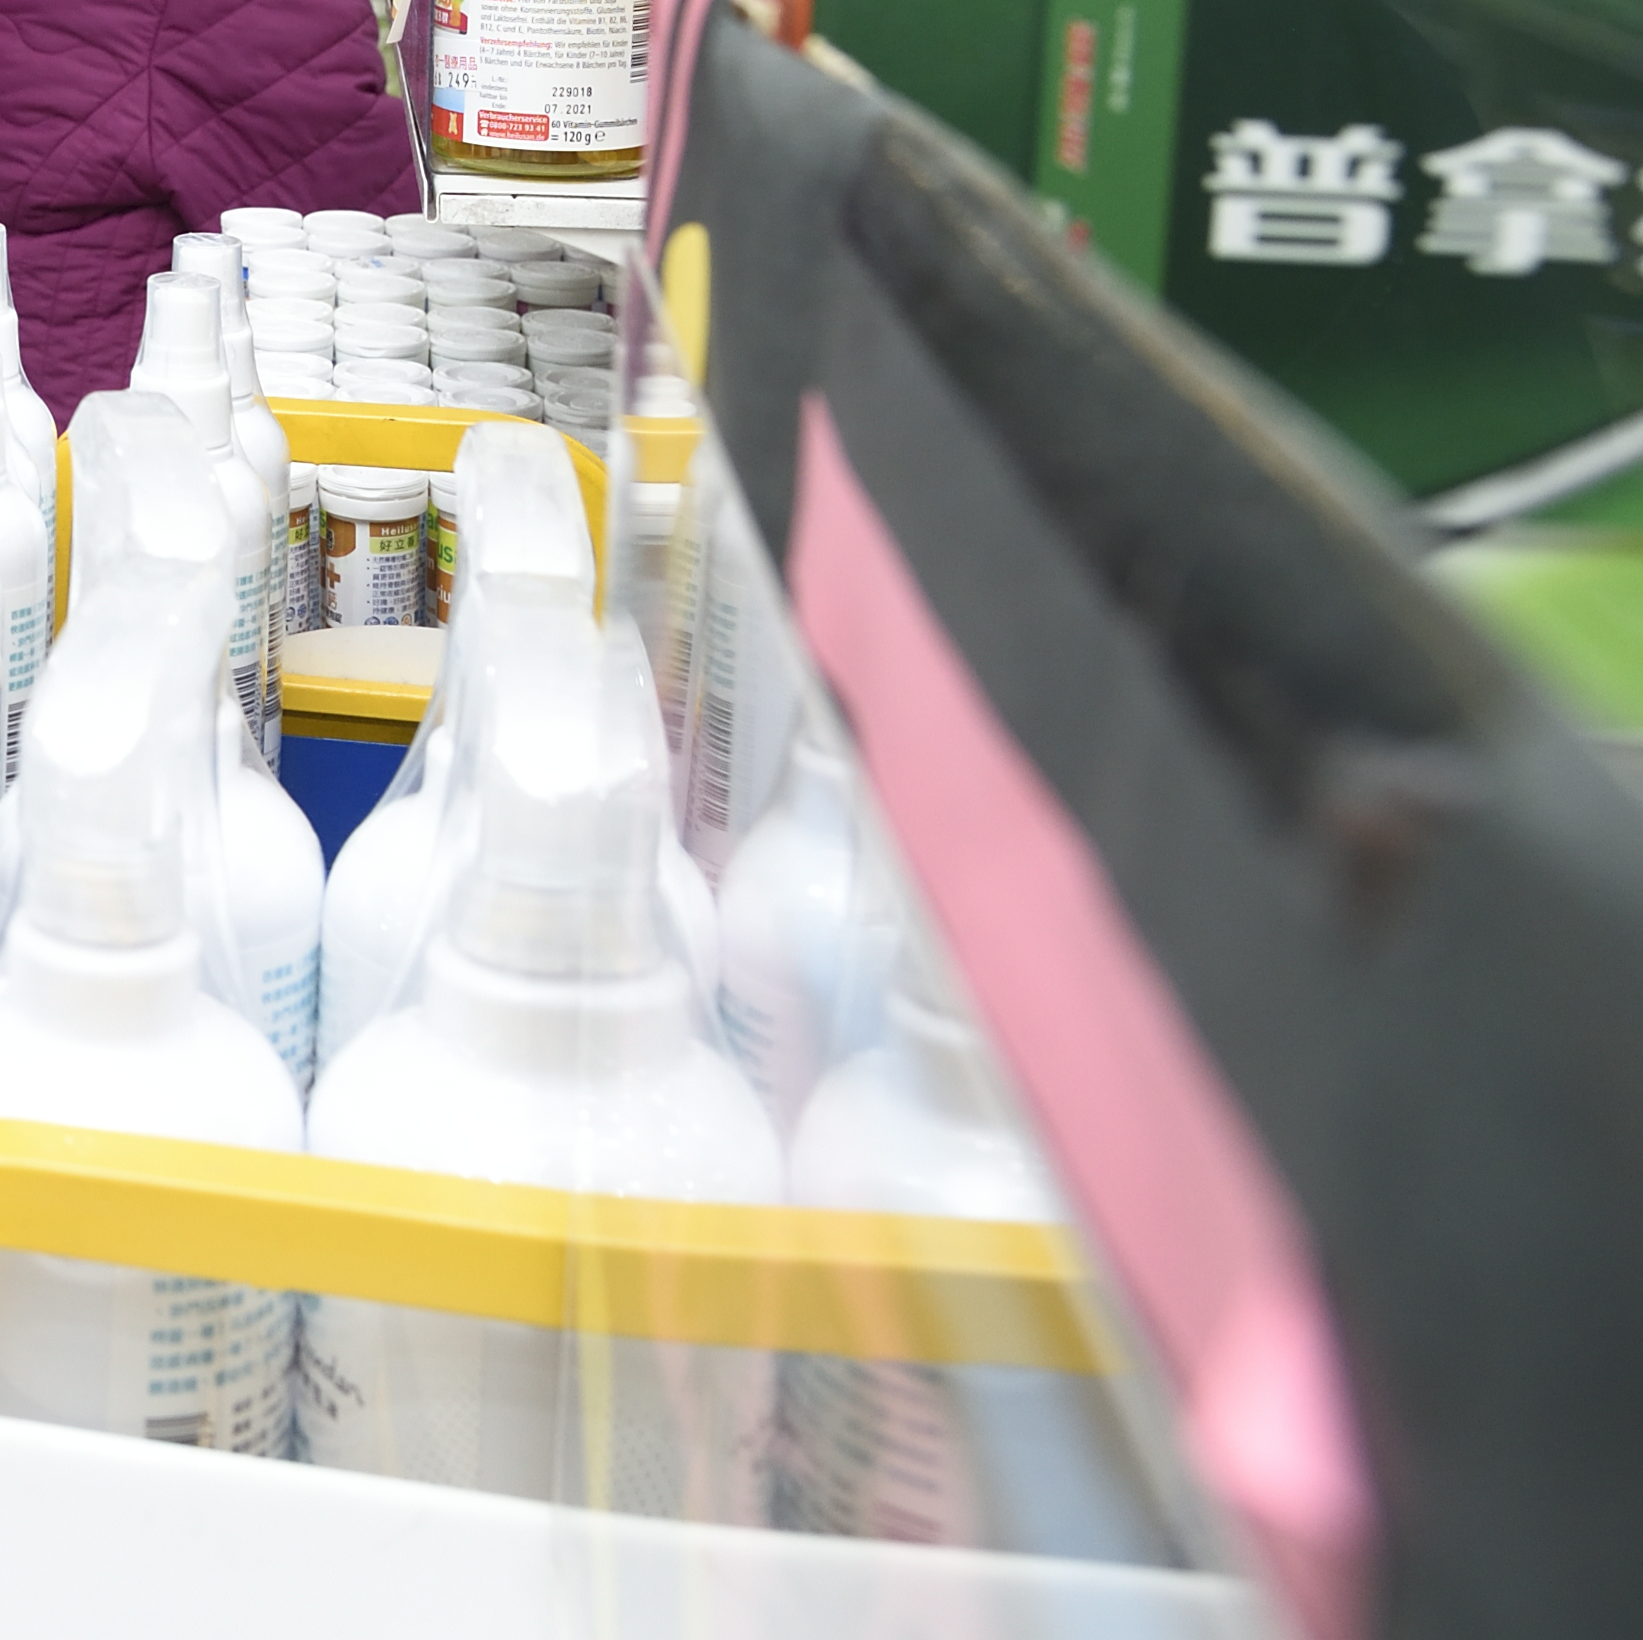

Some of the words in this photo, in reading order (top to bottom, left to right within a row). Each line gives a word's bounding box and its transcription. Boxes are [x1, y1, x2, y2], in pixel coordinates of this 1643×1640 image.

[552, 87, 593, 98] 229018
[479, 111, 548, 124] Verbraucherservice
[551, 120, 561, 128] 60
[564, 131, 582, 143] 120
[585, 133, 591, 146] g
[1201, 118, 1643, 276] 普拿
